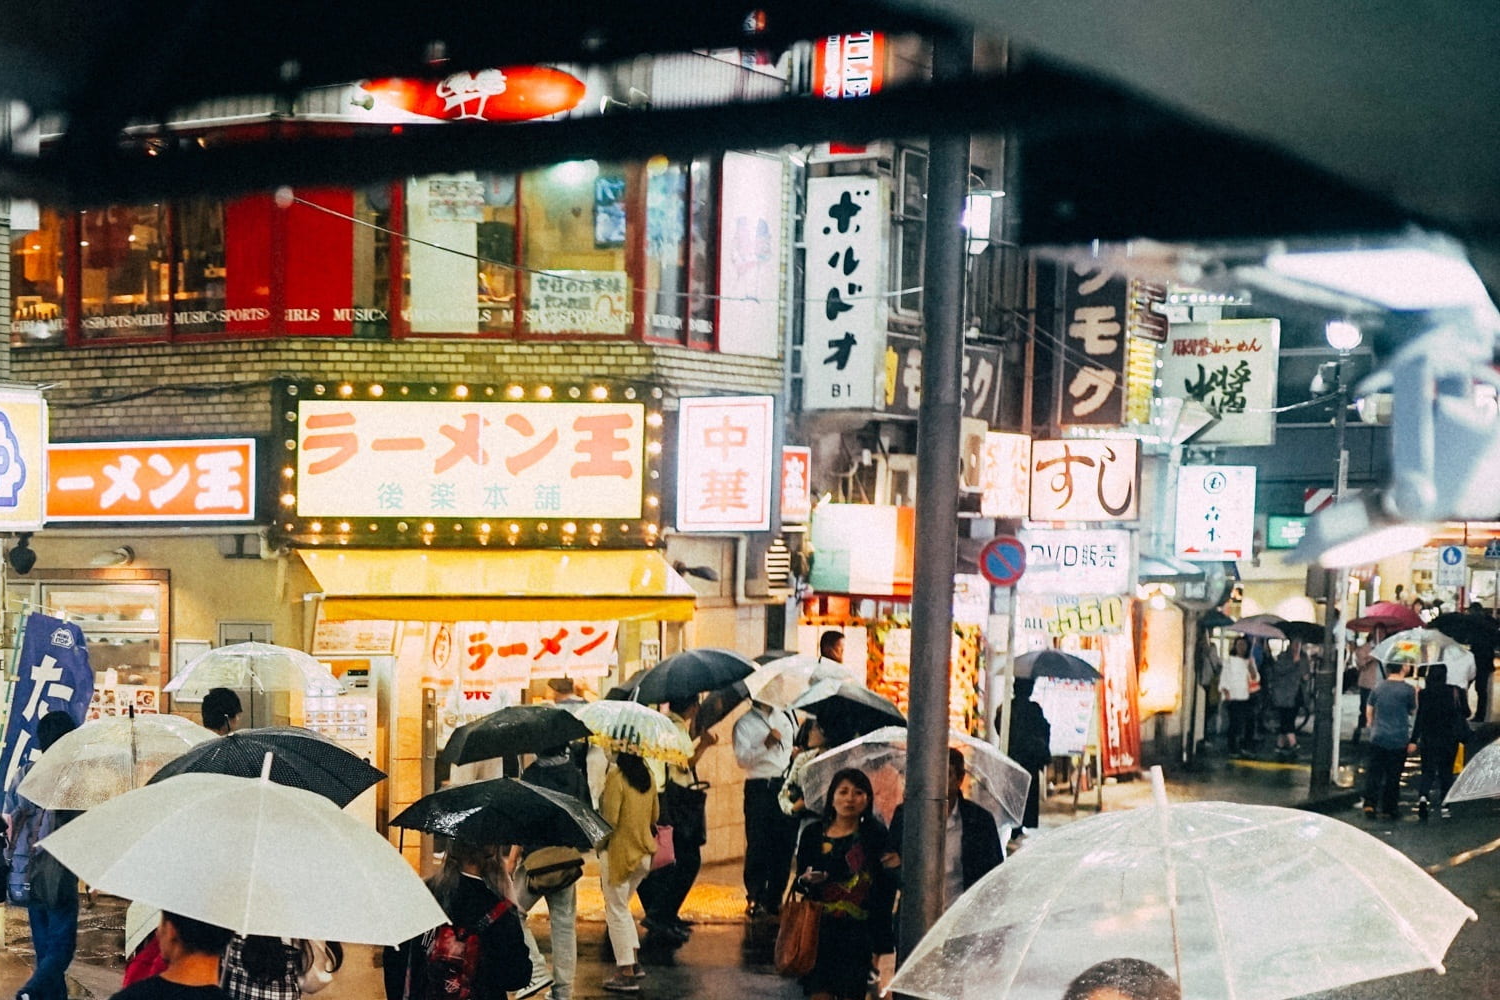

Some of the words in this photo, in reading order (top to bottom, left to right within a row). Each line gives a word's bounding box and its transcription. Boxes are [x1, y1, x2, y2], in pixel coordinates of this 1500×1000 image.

[831, 383, 852, 398] B1
[302, 412, 634, 480] ラーメン王
[699, 415, 749, 513] 中華
[47, 450, 244, 510] ーメン王
[377, 482, 562, 511] 後楽本舗
[1035, 443, 1133, 517] すし
[467, 626, 610, 672] ラーメン
